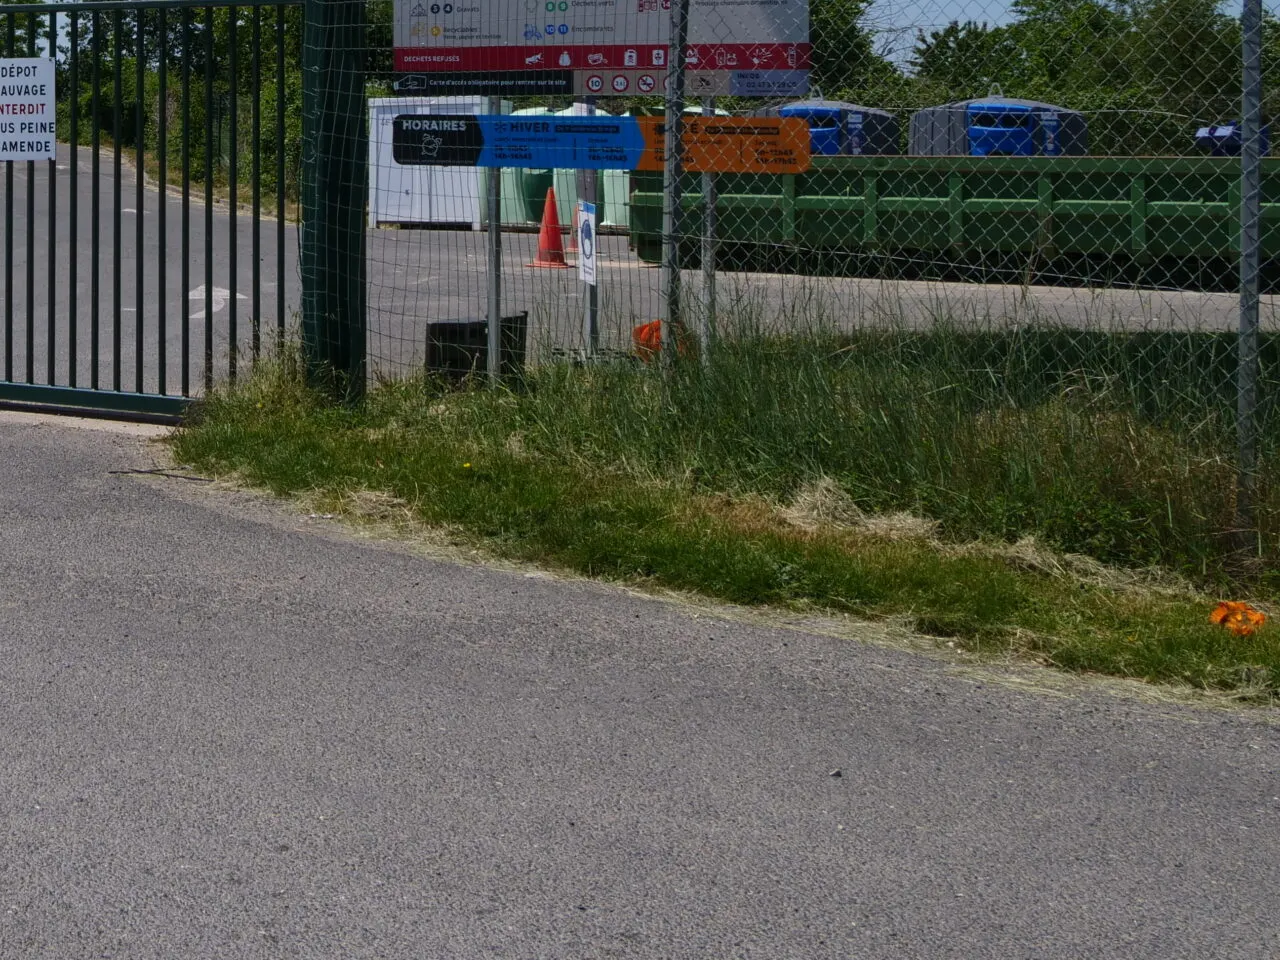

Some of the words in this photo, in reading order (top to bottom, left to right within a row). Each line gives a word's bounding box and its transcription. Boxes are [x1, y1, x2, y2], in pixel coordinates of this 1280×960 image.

[1, 64, 37, 78] DÉPOT
[468, 78, 499, 87] obligatoire
[20, 122, 55, 133] PEINE
[402, 120, 467, 131] HORAIRES
[510, 122, 549, 133] HIVER
